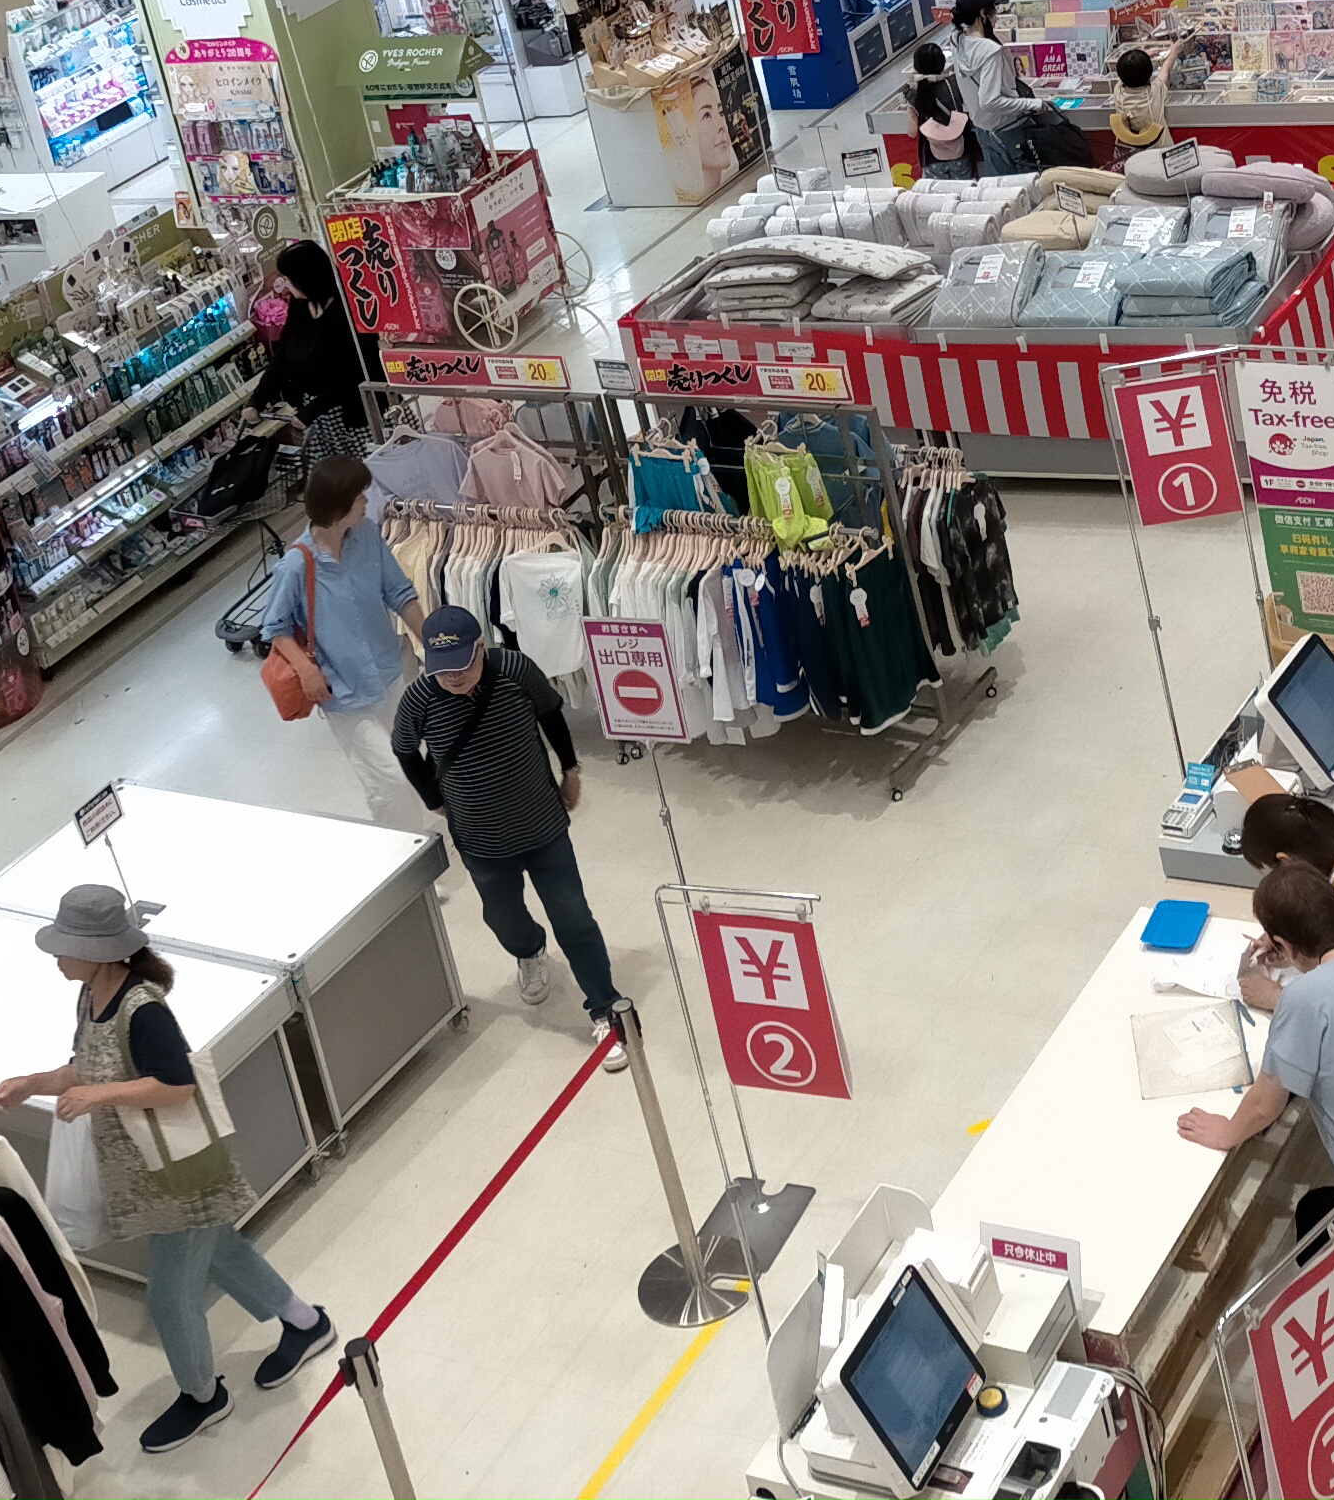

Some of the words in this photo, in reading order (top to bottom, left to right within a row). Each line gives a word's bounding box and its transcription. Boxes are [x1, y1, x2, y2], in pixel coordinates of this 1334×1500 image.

[381, 47, 404, 58] YVES
[405, 46, 444, 57] ROCHER
[1042, 63, 1066, 74] GREAT
[215, 76, 262, 88] ヒロインメイク
[327, 216, 364, 245] 閉店
[363, 217, 400, 308] 売り
[337, 245, 380, 330] つくし
[404, 354, 482, 384] 売りつくし
[528, 362, 547, 382] 20
[645, 367, 667, 384] 閉店
[667, 358, 753, 394] 売りつくし
[806, 371, 828, 392] 20
[1258, 377, 1318, 406] 免税
[1153, 394, 1197, 449] ¥
[616, 637, 639, 650] レジ
[598, 648, 664, 668] 出口専用
[734, 935, 792, 1001] ¥
[1004, 1243, 1057, 1265] 只今休止中
